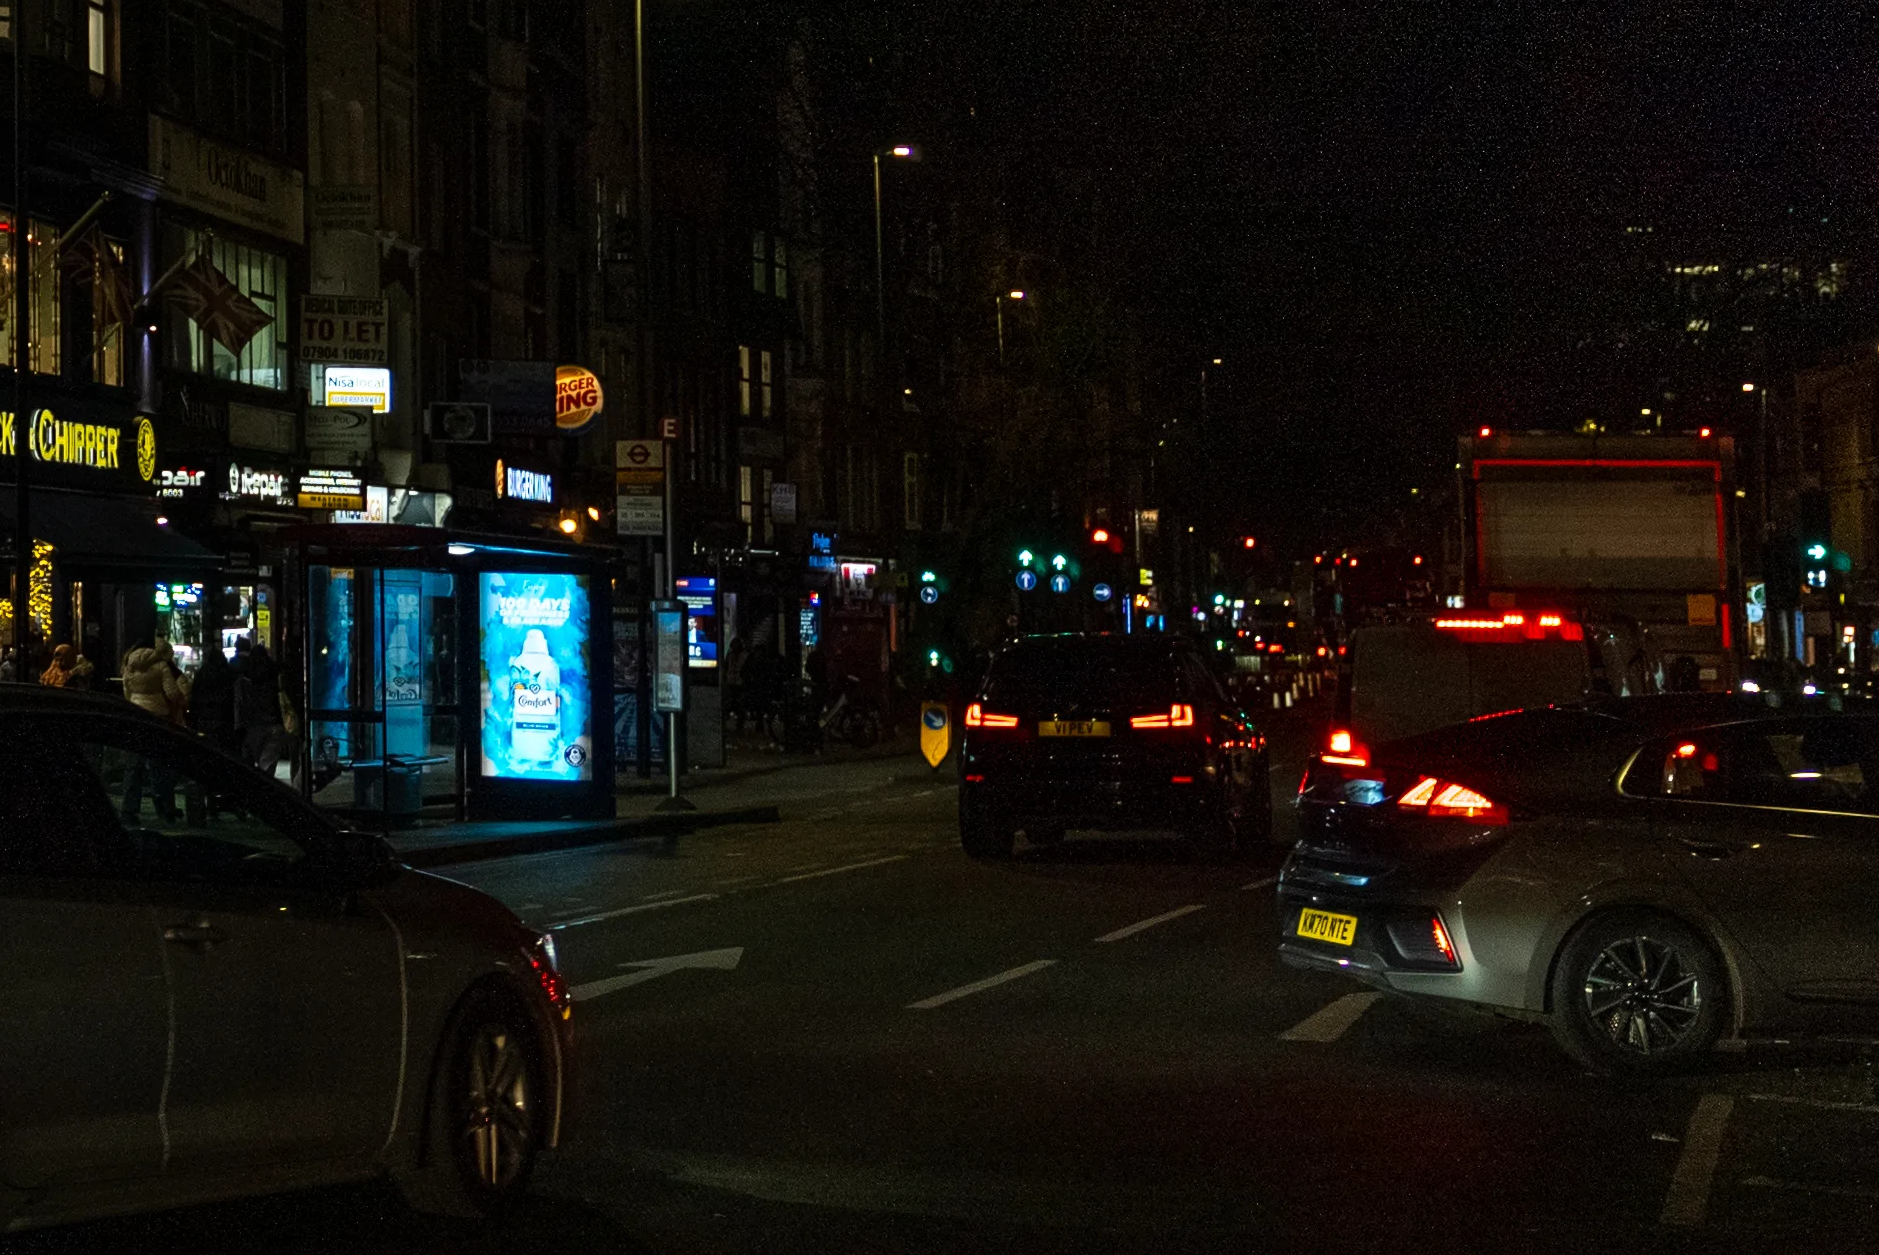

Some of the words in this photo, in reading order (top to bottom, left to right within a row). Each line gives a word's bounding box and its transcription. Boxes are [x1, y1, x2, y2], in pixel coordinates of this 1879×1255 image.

[304, 319, 335, 341] TO
[343, 320, 385, 343] LET
[303, 346, 338, 359] 07904
[328, 376, 354, 388] Nisa
[556, 378, 594, 395] RGER
[558, 389, 597, 414] ING
[663, 418, 676, 438] E
[36, 409, 120, 469] CHIPPER
[530, 597, 571, 610] DAYS
[518, 695, 552, 708] Comfort
